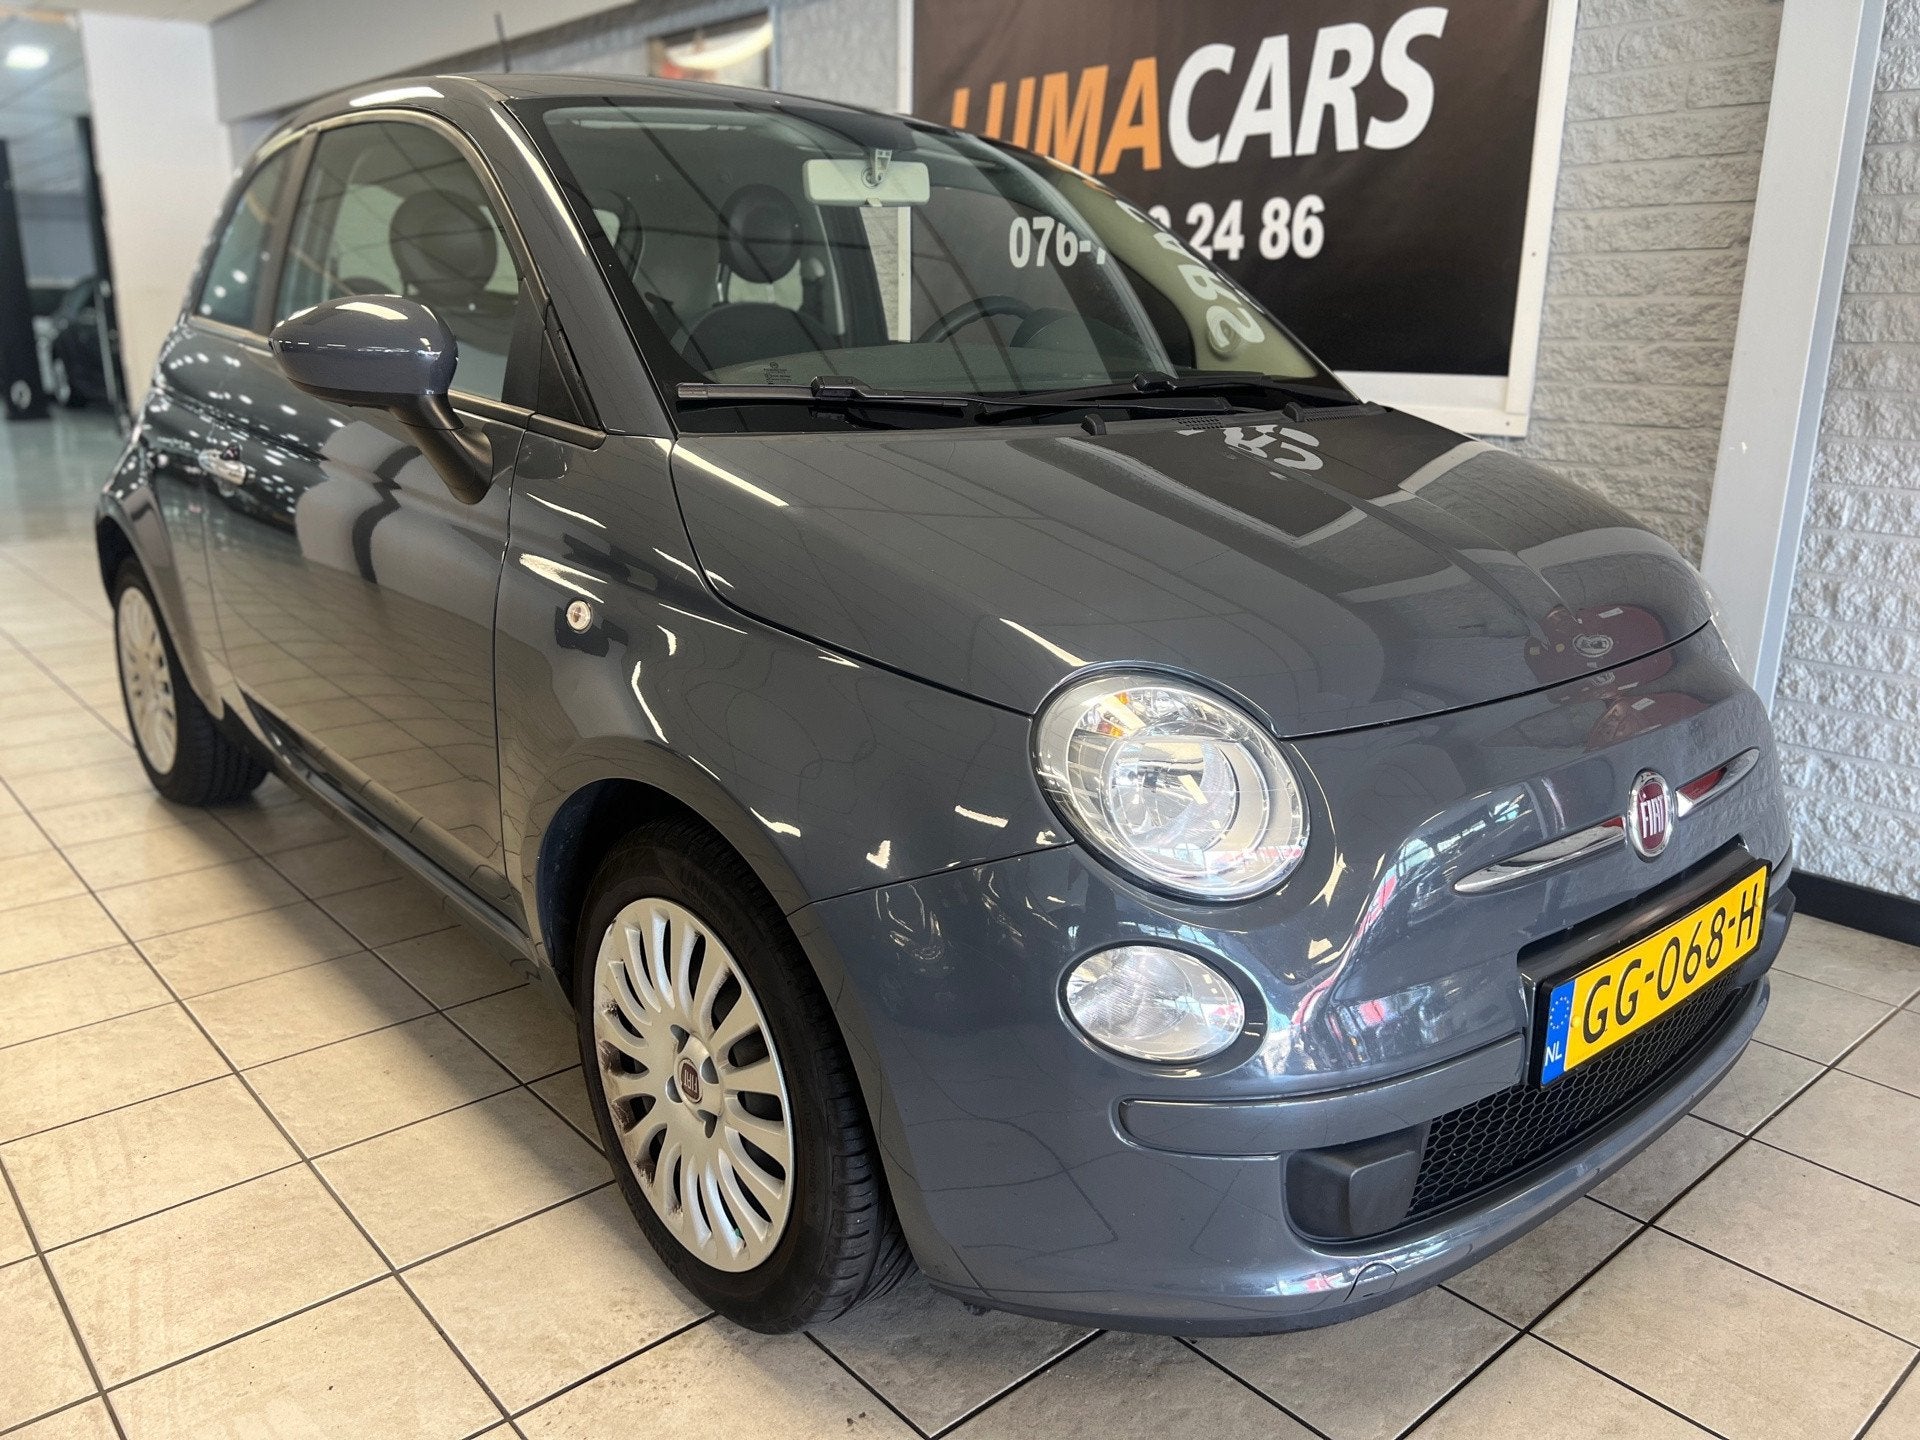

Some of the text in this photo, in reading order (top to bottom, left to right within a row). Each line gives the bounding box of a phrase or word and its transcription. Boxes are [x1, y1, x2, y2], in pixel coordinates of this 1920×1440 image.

[1185, 199, 1245, 261] 24
[1258, 194, 1326, 260] 86
[1639, 794, 1665, 839] FIAT
[1582, 882, 1759, 1045] GG-068-H
[1544, 1040, 1563, 1068] NL
[683, 1069, 699, 1094] FIAT
